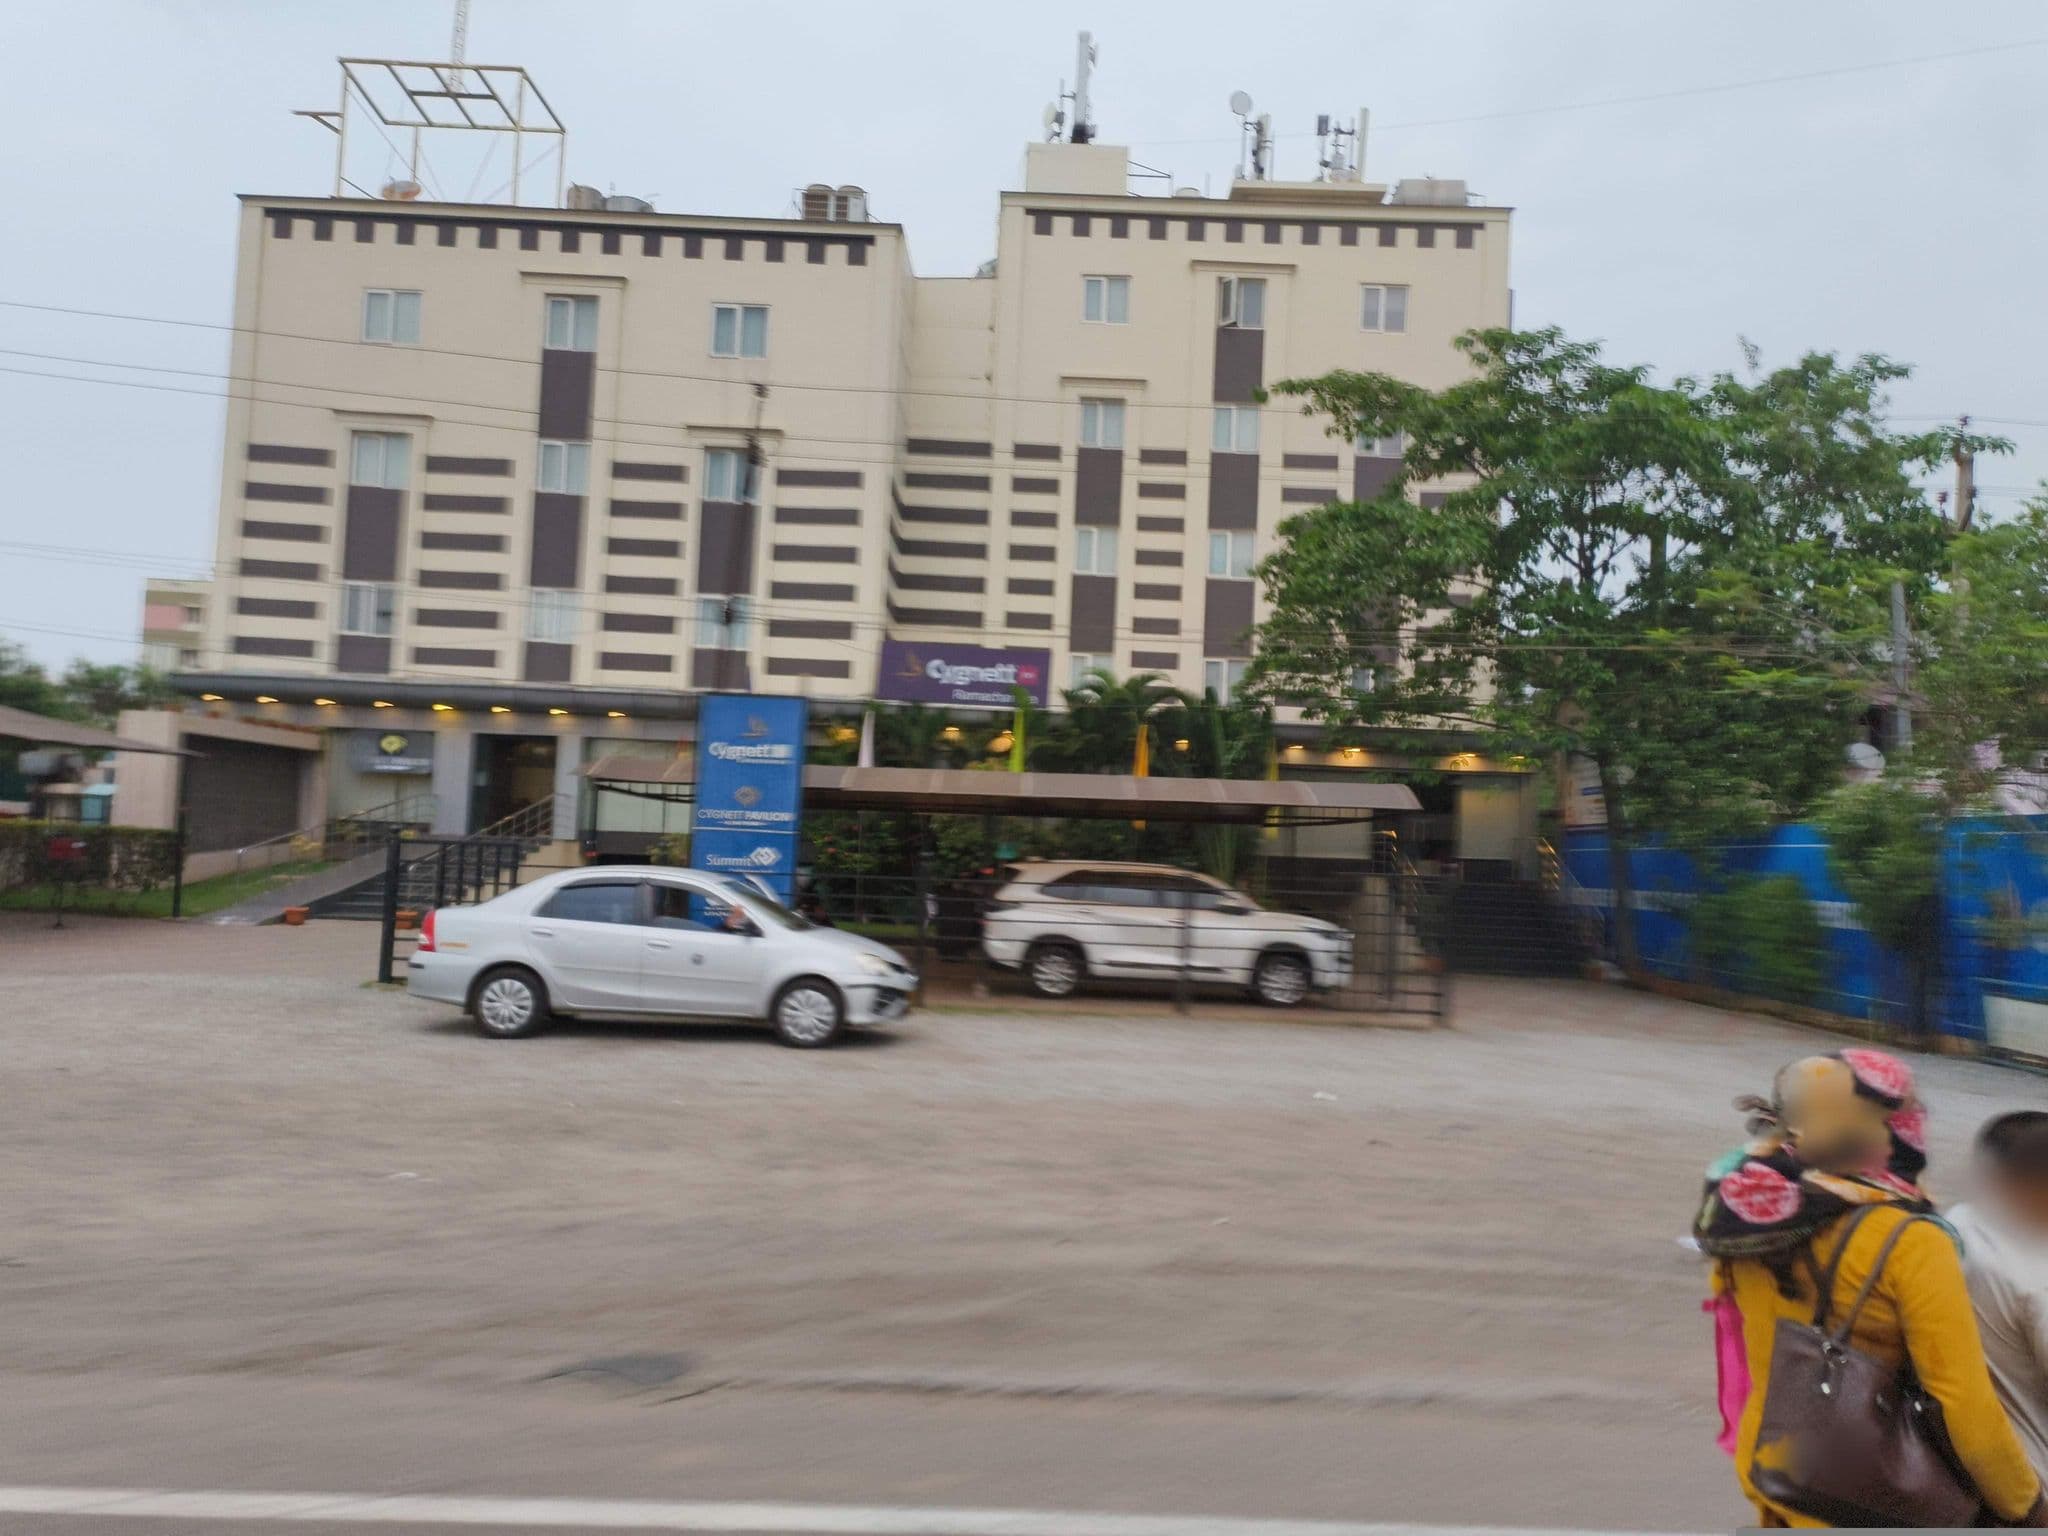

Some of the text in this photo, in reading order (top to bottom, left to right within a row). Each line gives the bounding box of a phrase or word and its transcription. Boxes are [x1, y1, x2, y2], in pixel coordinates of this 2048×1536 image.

[926, 659, 1017, 685] Cygnett
[708, 742, 770, 760] Cygnett
[697, 809, 743, 819] CYGNETT
[705, 854, 752, 866] Summit
